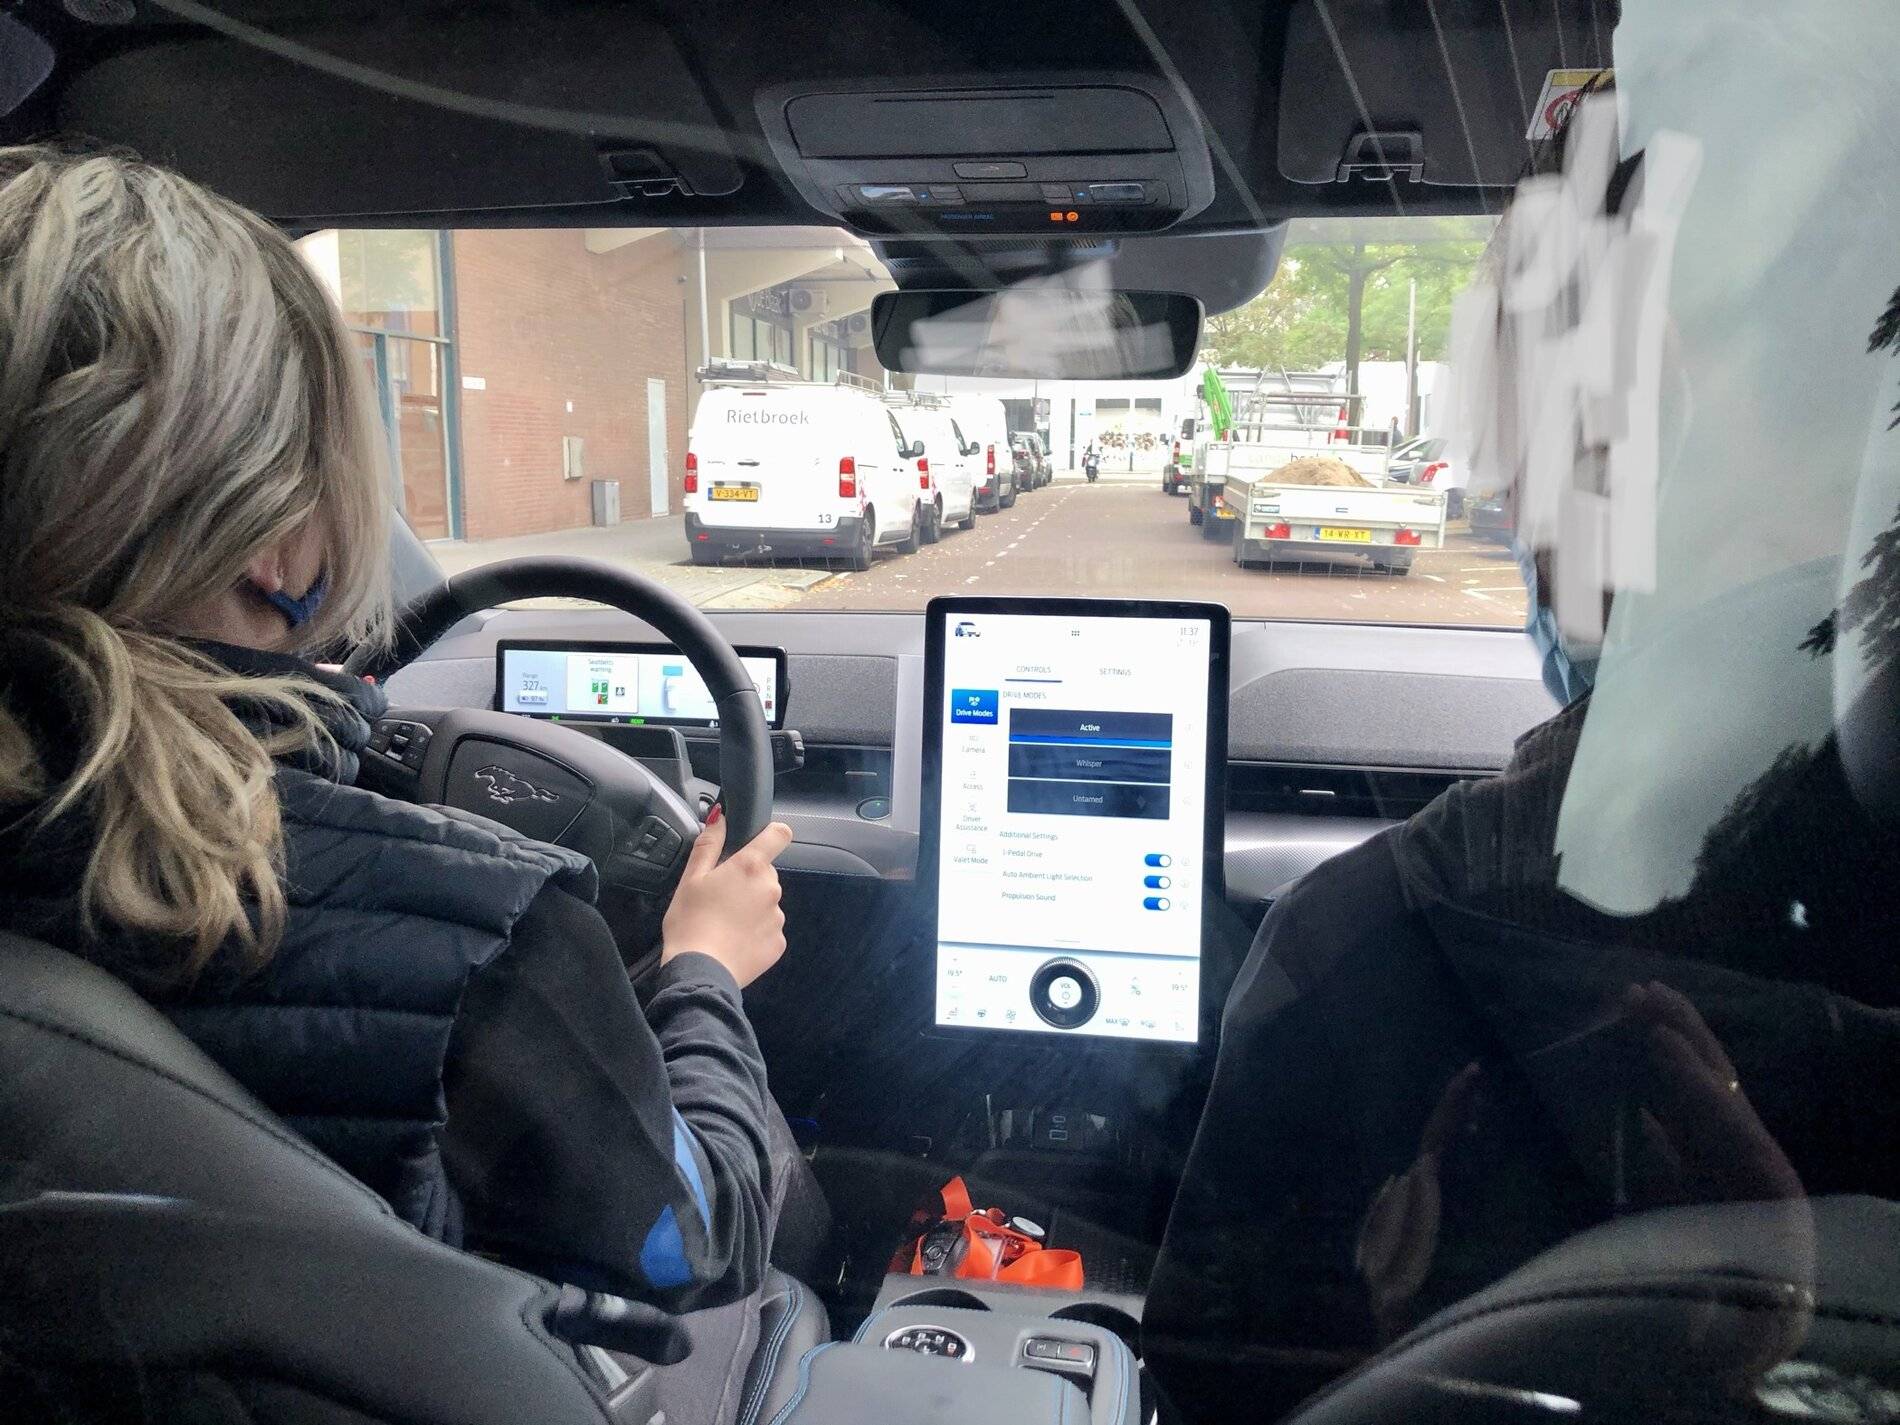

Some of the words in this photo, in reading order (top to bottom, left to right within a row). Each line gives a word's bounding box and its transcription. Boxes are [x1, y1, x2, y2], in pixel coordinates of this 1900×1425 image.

[726, 409, 810, 426] Rietbroek
[818, 513, 833, 524] 13
[1016, 665, 1052, 674] CONTROLS
[1099, 668, 1132, 676] SETTINGS
[523, 680, 539, 691] 327
[956, 709, 973, 717] Drive
[975, 710, 994, 718] Modes
[1080, 723, 1101, 732] Active
[1076, 759, 1103, 768] Whisper
[1072, 794, 1104, 804] Untamed
[988, 975, 1008, 983] AUTO
